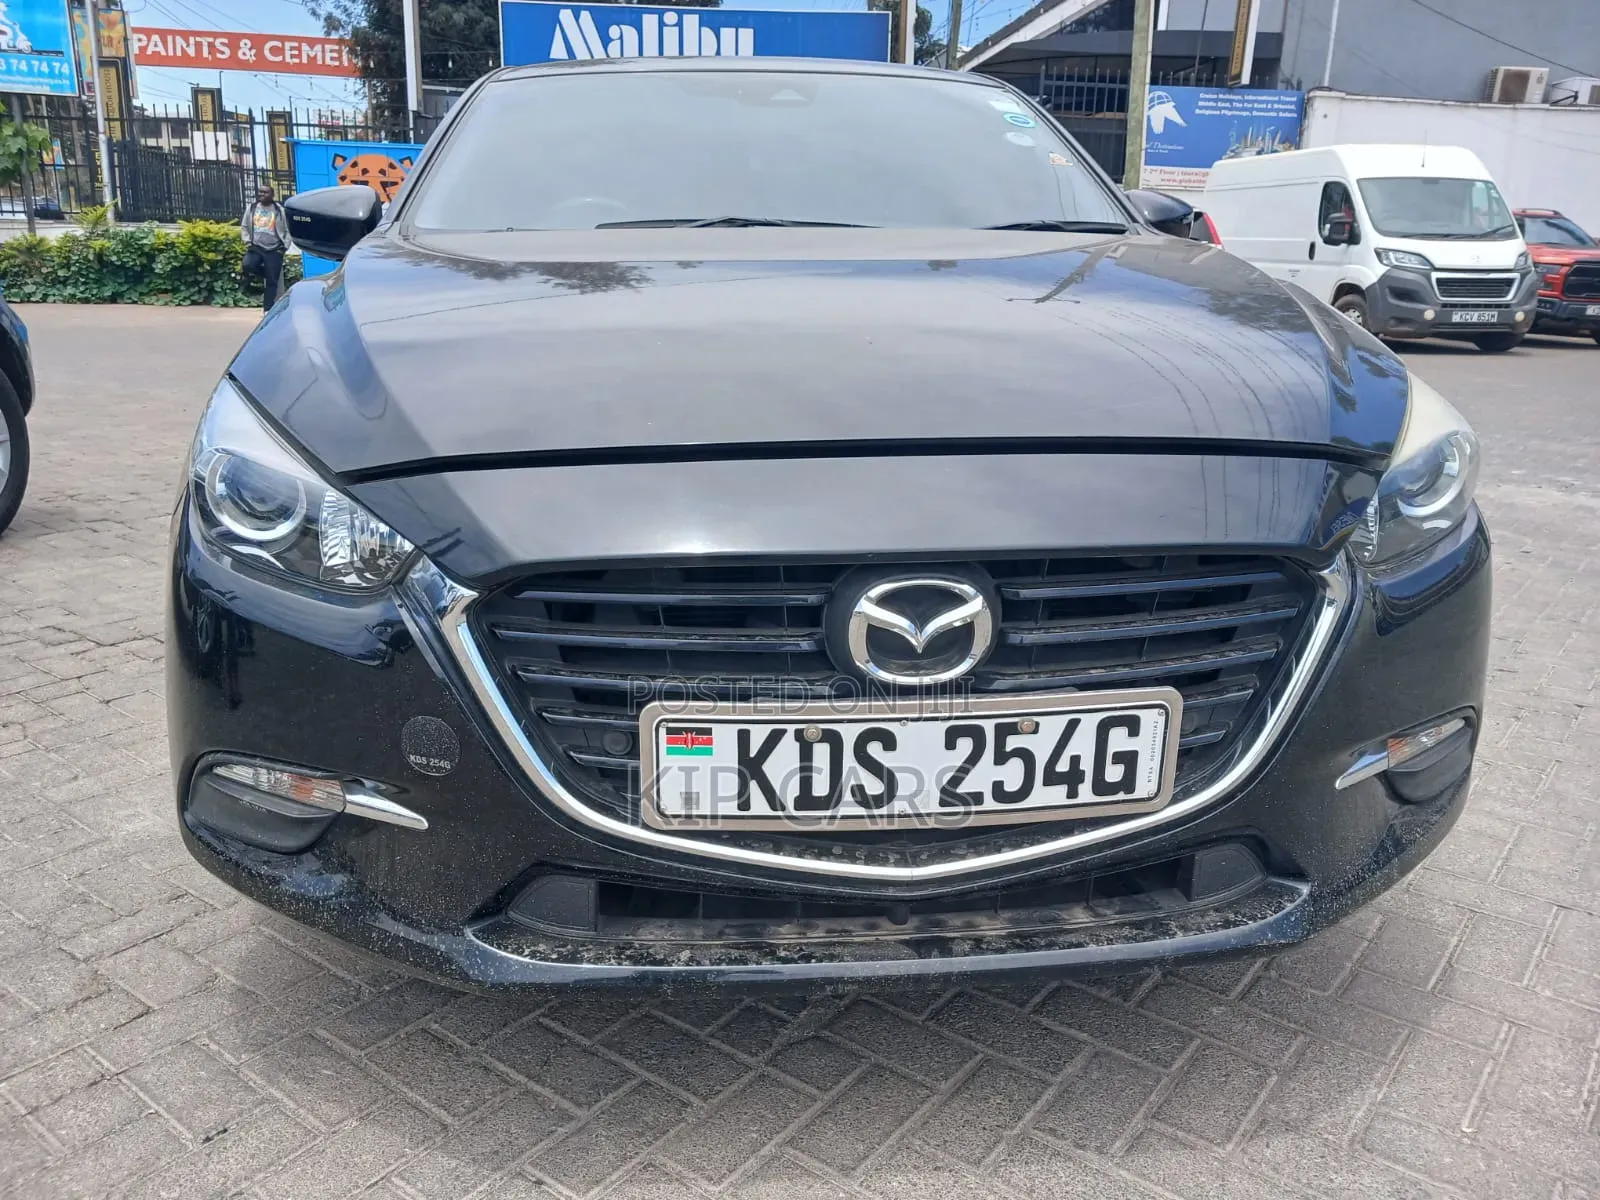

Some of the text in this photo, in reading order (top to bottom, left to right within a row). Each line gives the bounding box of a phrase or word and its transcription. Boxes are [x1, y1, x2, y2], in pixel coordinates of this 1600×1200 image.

[549, 9, 754, 60] Malibu
[133, 33, 231, 59] PAINTS
[237, 39, 256, 61] &
[264, 40, 374, 68] CEMEN
[9, 59, 28, 72] 74
[31, 60, 49, 74] 74
[51, 61, 70, 75] 74
[1460, 311, 1474, 321] KCV
[409, 754, 451, 769] KDS 254G
[737, 714, 1141, 812] KDS 254G
